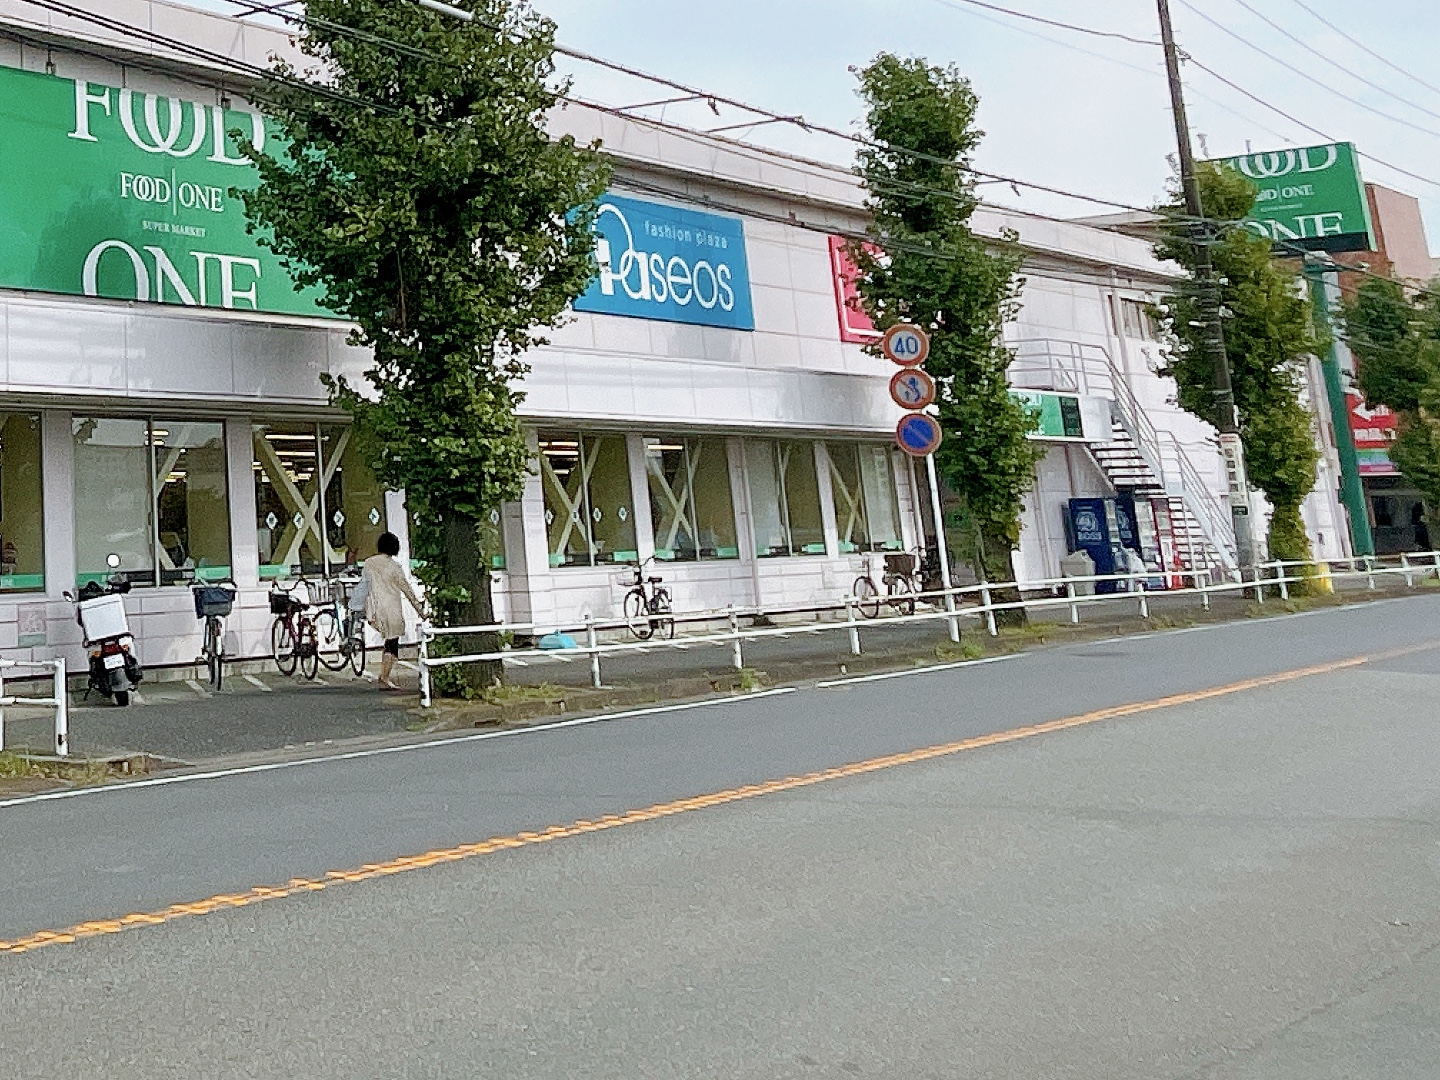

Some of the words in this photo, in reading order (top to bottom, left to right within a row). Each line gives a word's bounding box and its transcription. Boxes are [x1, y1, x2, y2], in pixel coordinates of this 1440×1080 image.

[67, 79, 265, 166] FOOD
[120, 172, 170, 203] FOOD
[178, 181, 225, 212] ONE
[592, 203, 734, 312] Paseos
[644, 220, 692, 242] fashion
[695, 228, 728, 248] plaza
[83, 239, 262, 309] ONE
[894, 336, 919, 355] 40
